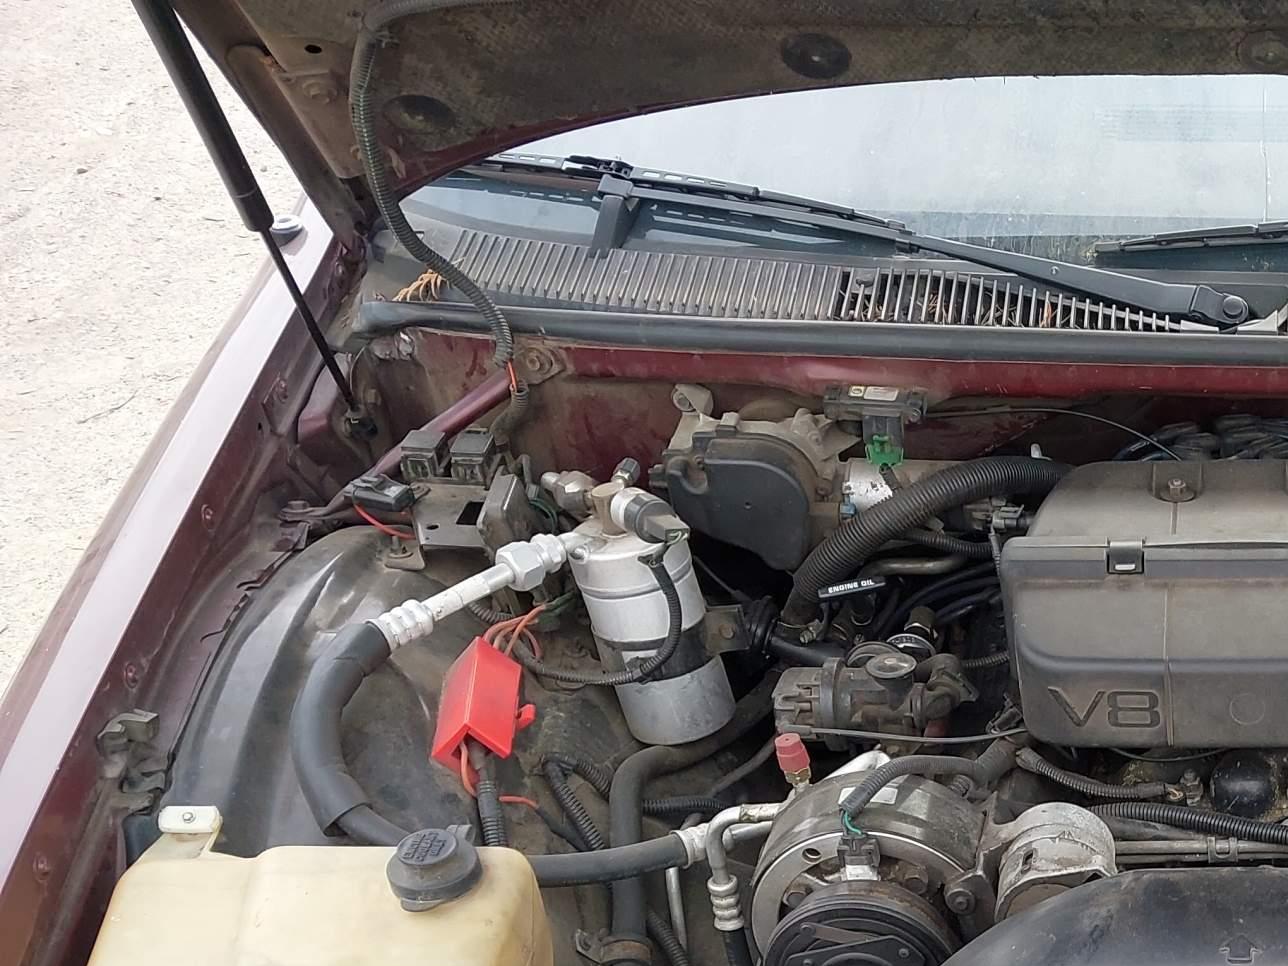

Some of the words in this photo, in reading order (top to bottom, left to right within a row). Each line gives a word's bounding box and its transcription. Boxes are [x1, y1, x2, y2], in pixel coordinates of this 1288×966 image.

[828, 581, 859, 594] ENGINE
[861, 578, 875, 587] OIL
[1047, 685, 1162, 728] V8
